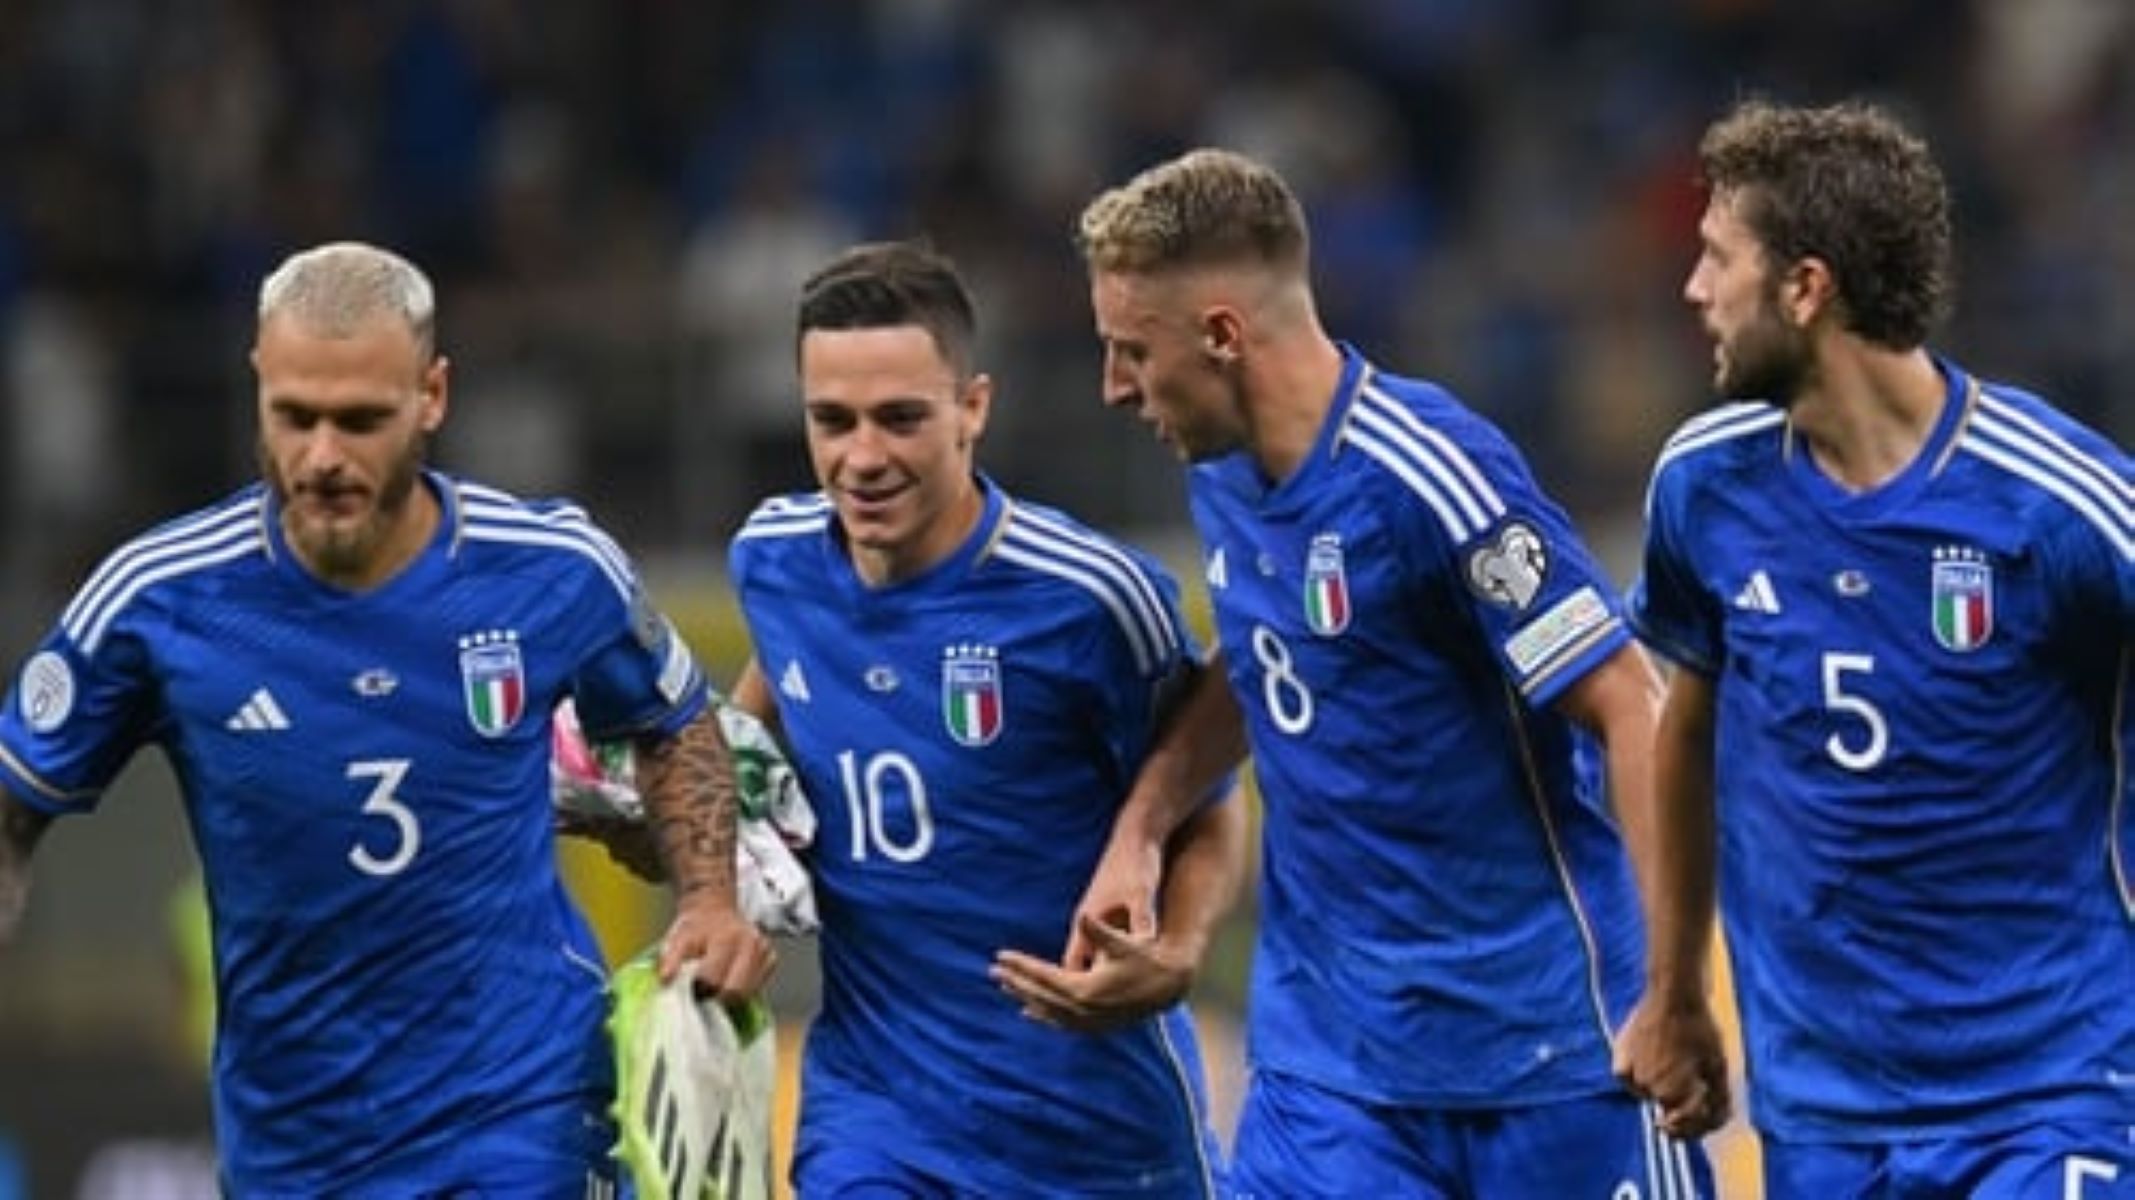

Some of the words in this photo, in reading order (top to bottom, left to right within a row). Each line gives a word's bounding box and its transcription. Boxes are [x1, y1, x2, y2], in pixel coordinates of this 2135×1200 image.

[1252, 626, 1314, 735] 8
[1821, 651, 1888, 769] 5
[346, 758, 420, 876] 3
[838, 750, 935, 863] 10
